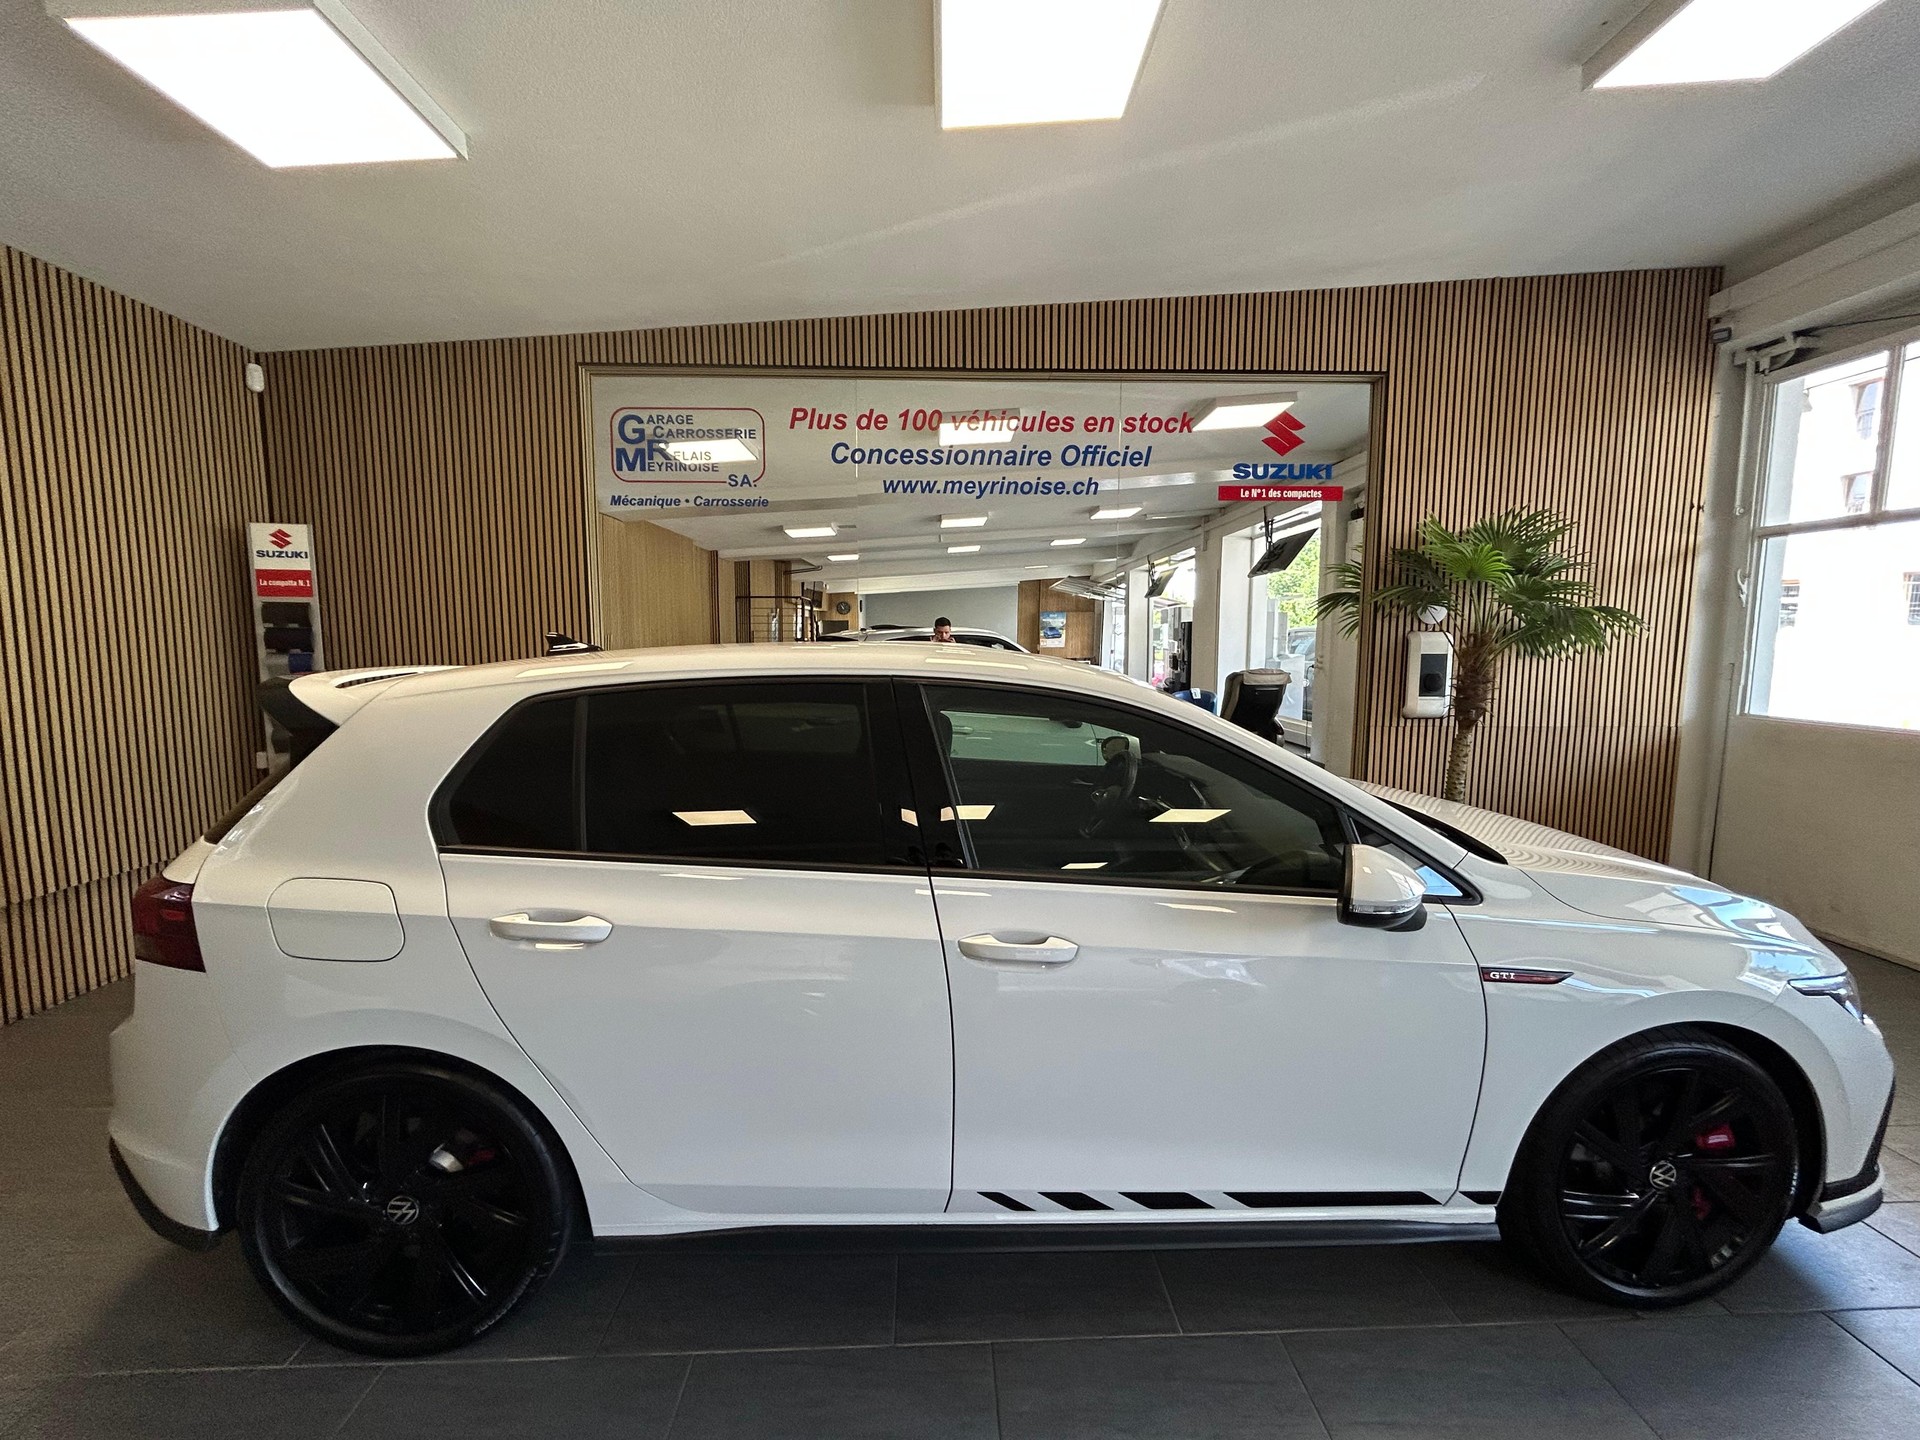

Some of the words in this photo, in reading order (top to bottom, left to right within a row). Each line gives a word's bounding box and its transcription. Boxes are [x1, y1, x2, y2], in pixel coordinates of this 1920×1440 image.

[789, 407, 848, 430] Plus
[856, 408, 888, 431] de
[898, 409, 943, 431] 100
[952, 409, 1075, 433] véhicules
[1083, 415, 1115, 433] en
[1122, 411, 1196, 434] stock
[617, 414, 694, 445] GARAGE
[653, 426, 757, 439] CARROSSERIE
[647, 439, 712, 461] RELAIS
[831, 442, 1052, 467] Concessionnaire
[1060, 444, 1152, 467] Officiel
[615, 447, 719, 472] MEYRINOISE
[1232, 463, 1333, 480] SUZUKI
[728, 474, 757, 487] SA.
[883, 476, 1100, 500] www.meyrinoise.ch
[610, 494, 681, 509] Mécanique
[693, 496, 769, 508] Carrosserie
[1240, 488, 1249, 498] Le
[1268, 488, 1282, 498] des
[1283, 489, 1322, 500] compactes
[255, 549, 309, 559] SUZUKI
[1489, 971, 1515, 980] GTI
